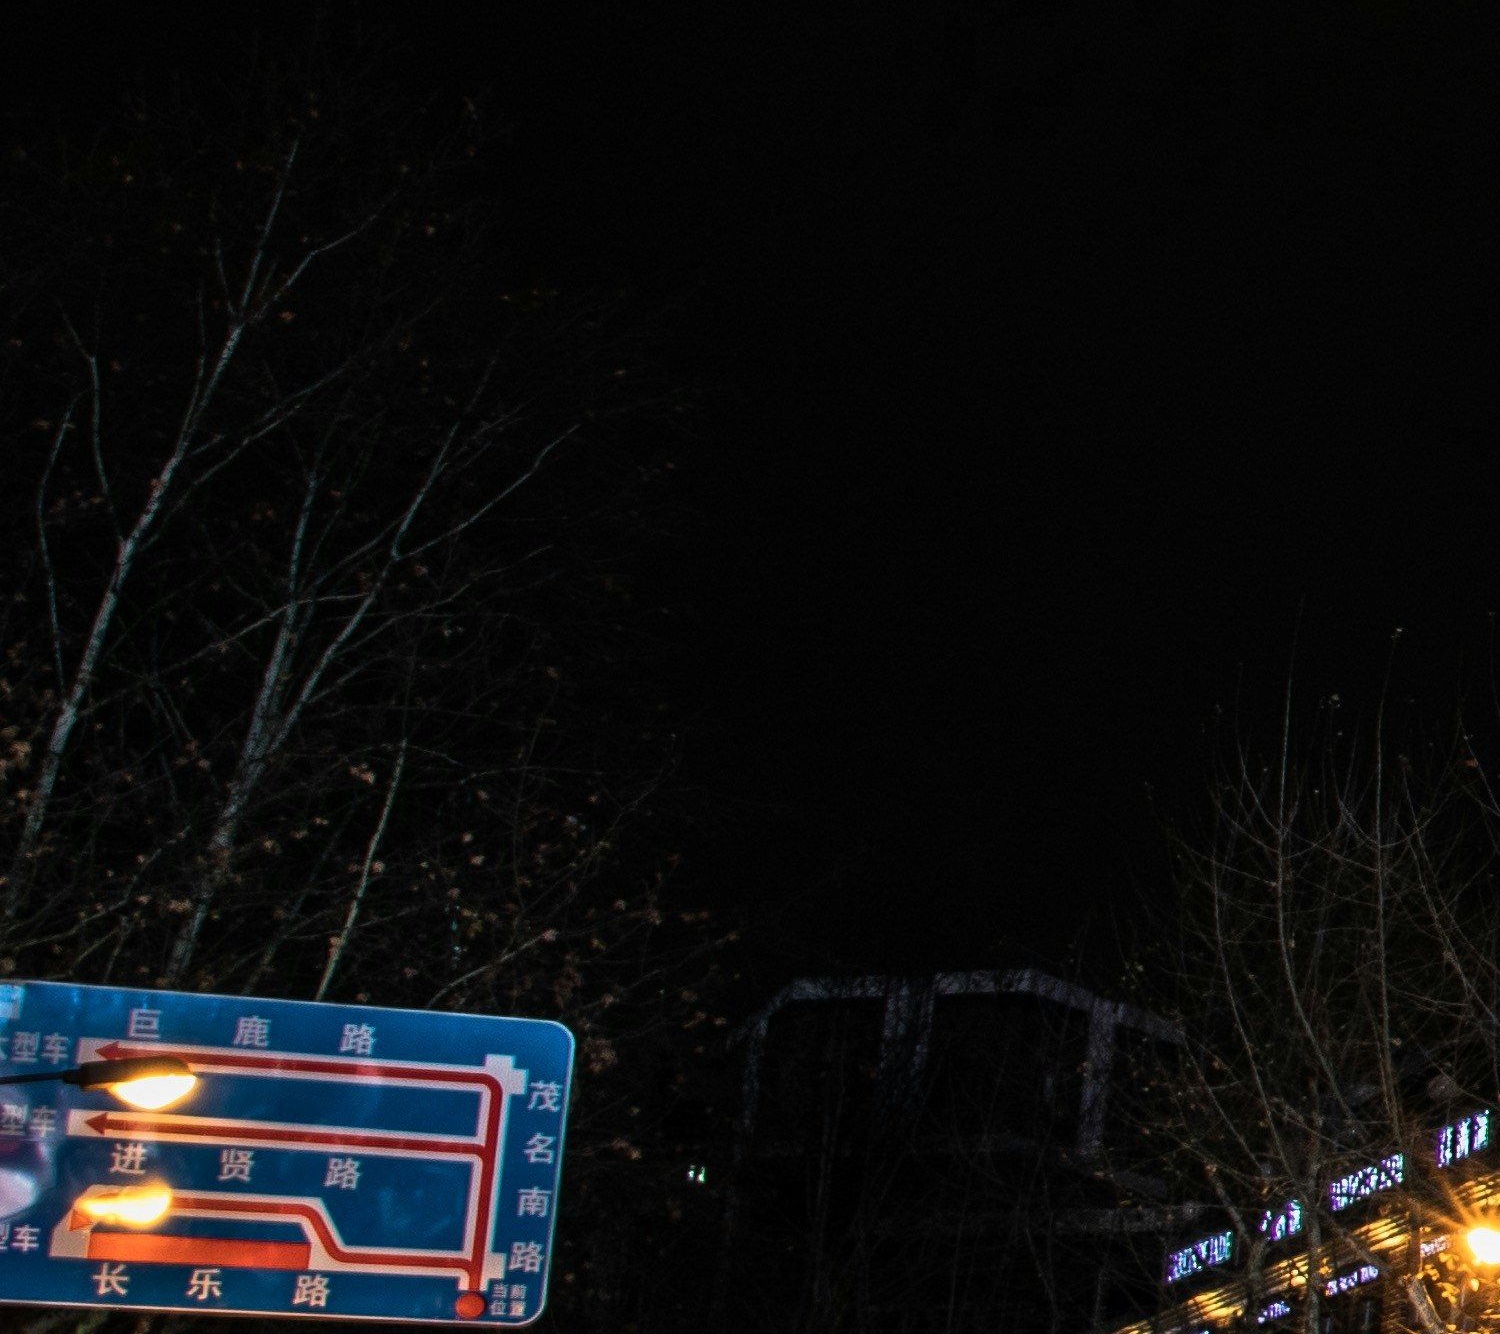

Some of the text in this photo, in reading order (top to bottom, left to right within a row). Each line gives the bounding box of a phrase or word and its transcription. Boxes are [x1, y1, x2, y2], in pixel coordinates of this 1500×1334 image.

[127, 1008, 378, 1056] 巨鹿路
[109, 1142, 362, 1191] 进贤路
[508, 1079, 563, 1274] 茂名南路
[92, 1264, 332, 1308] 长乐路
